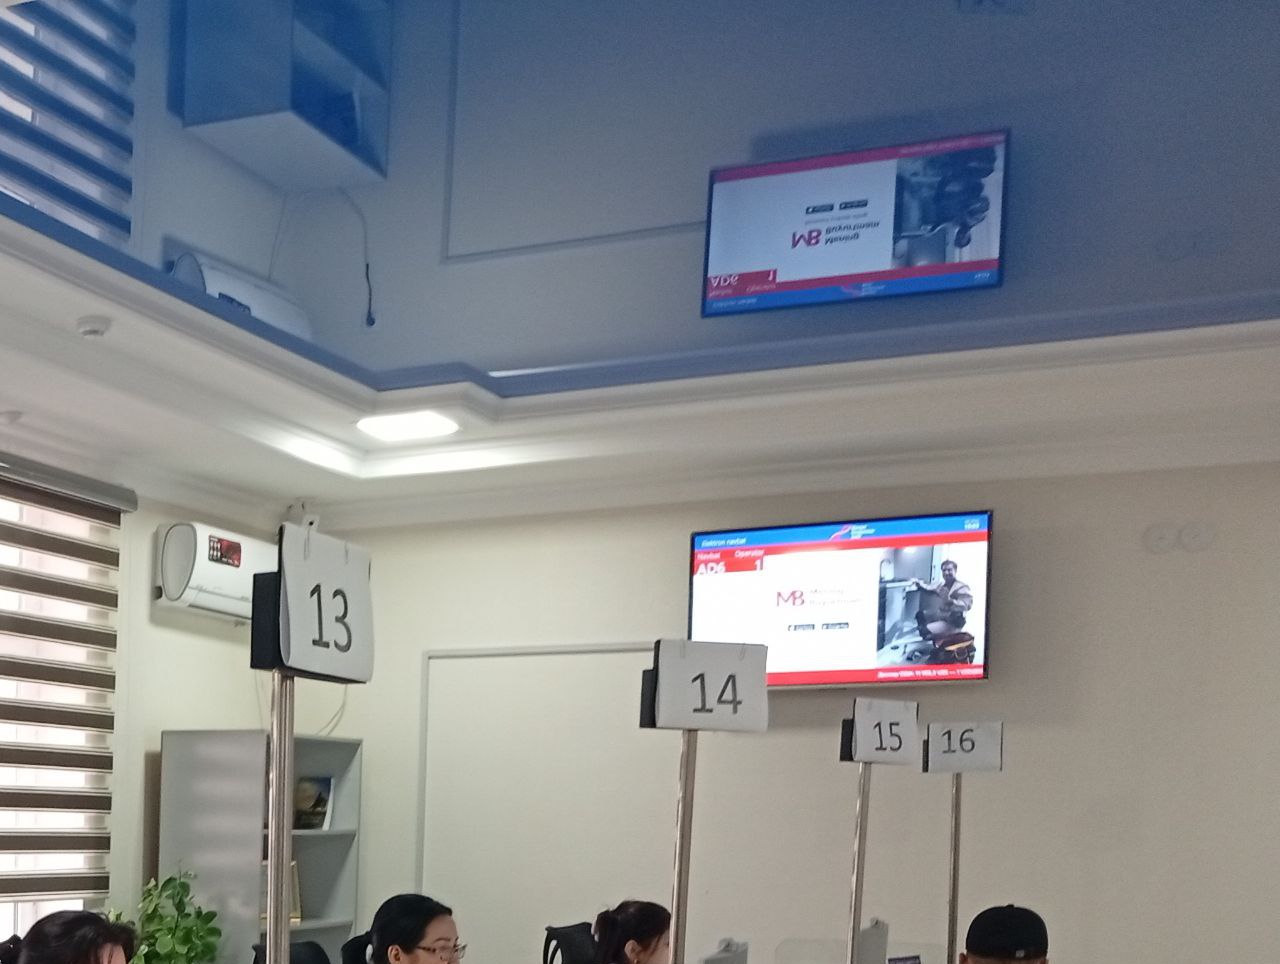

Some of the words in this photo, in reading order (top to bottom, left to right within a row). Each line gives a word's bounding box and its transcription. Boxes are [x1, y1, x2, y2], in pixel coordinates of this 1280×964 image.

[776, 589, 805, 607] MB
[310, 582, 353, 653] 13
[691, 673, 742, 715] 14
[873, 721, 903, 752] 15
[941, 728, 976, 754] 16
